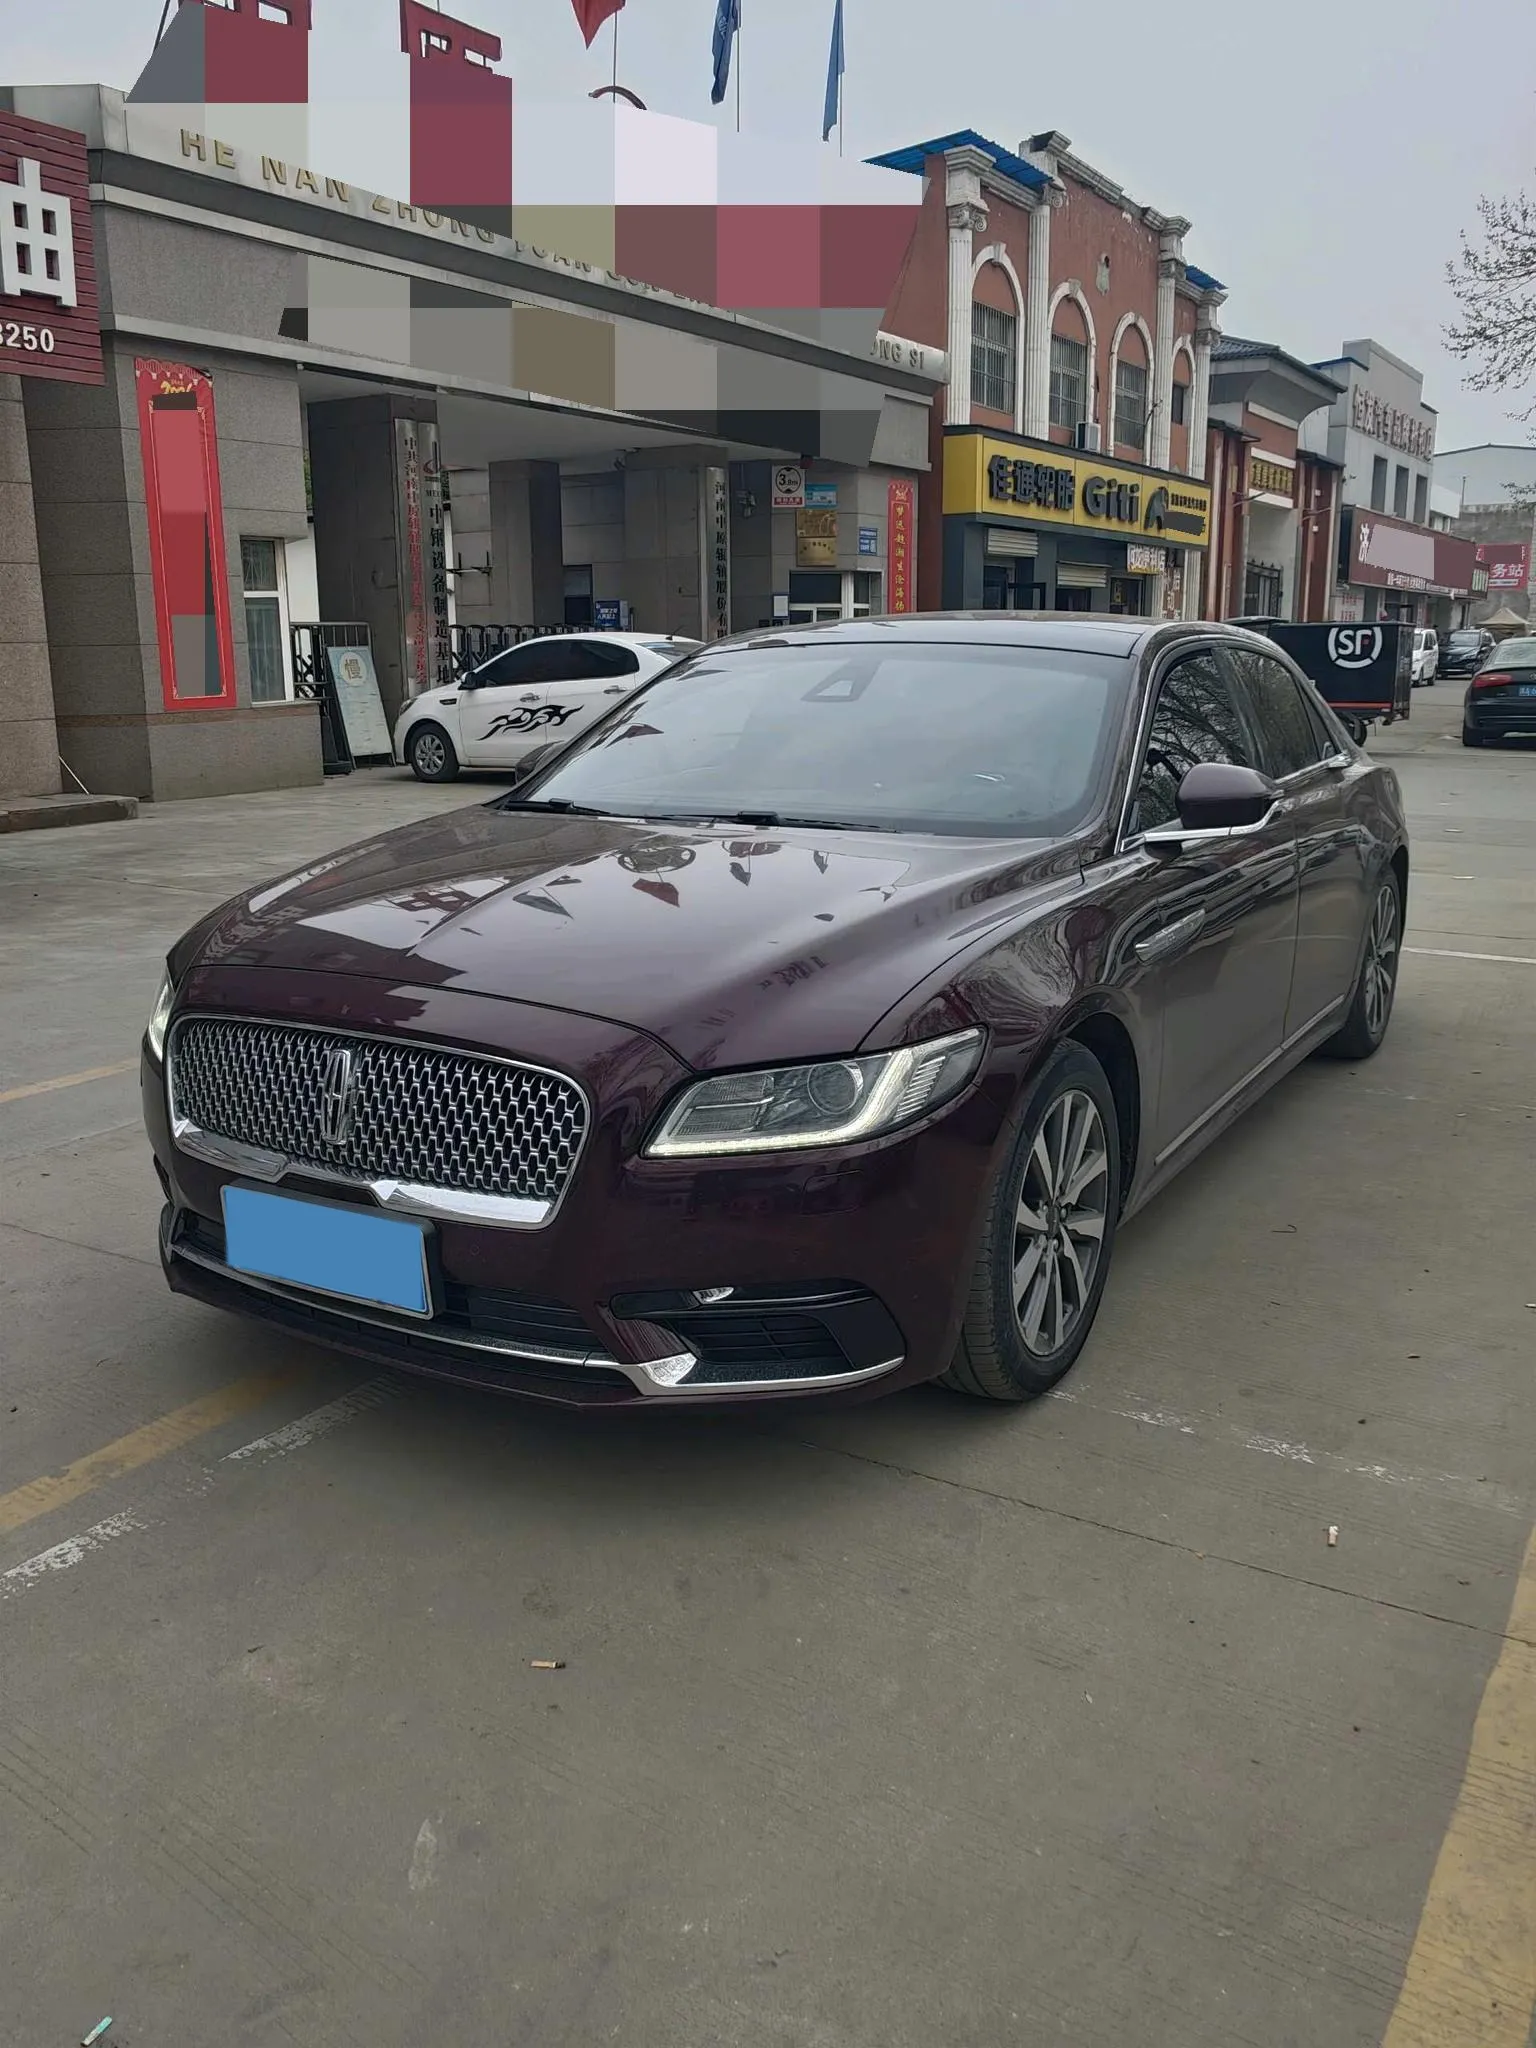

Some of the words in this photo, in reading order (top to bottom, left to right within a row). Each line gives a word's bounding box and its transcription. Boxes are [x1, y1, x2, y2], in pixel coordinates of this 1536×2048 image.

[181, 128, 235, 169] HE
[261, 155, 349, 202] NAN
[909, 348, 925, 369] SI
[1082, 476, 1139, 525] Giti
[1337, 629, 1372, 655] SF
